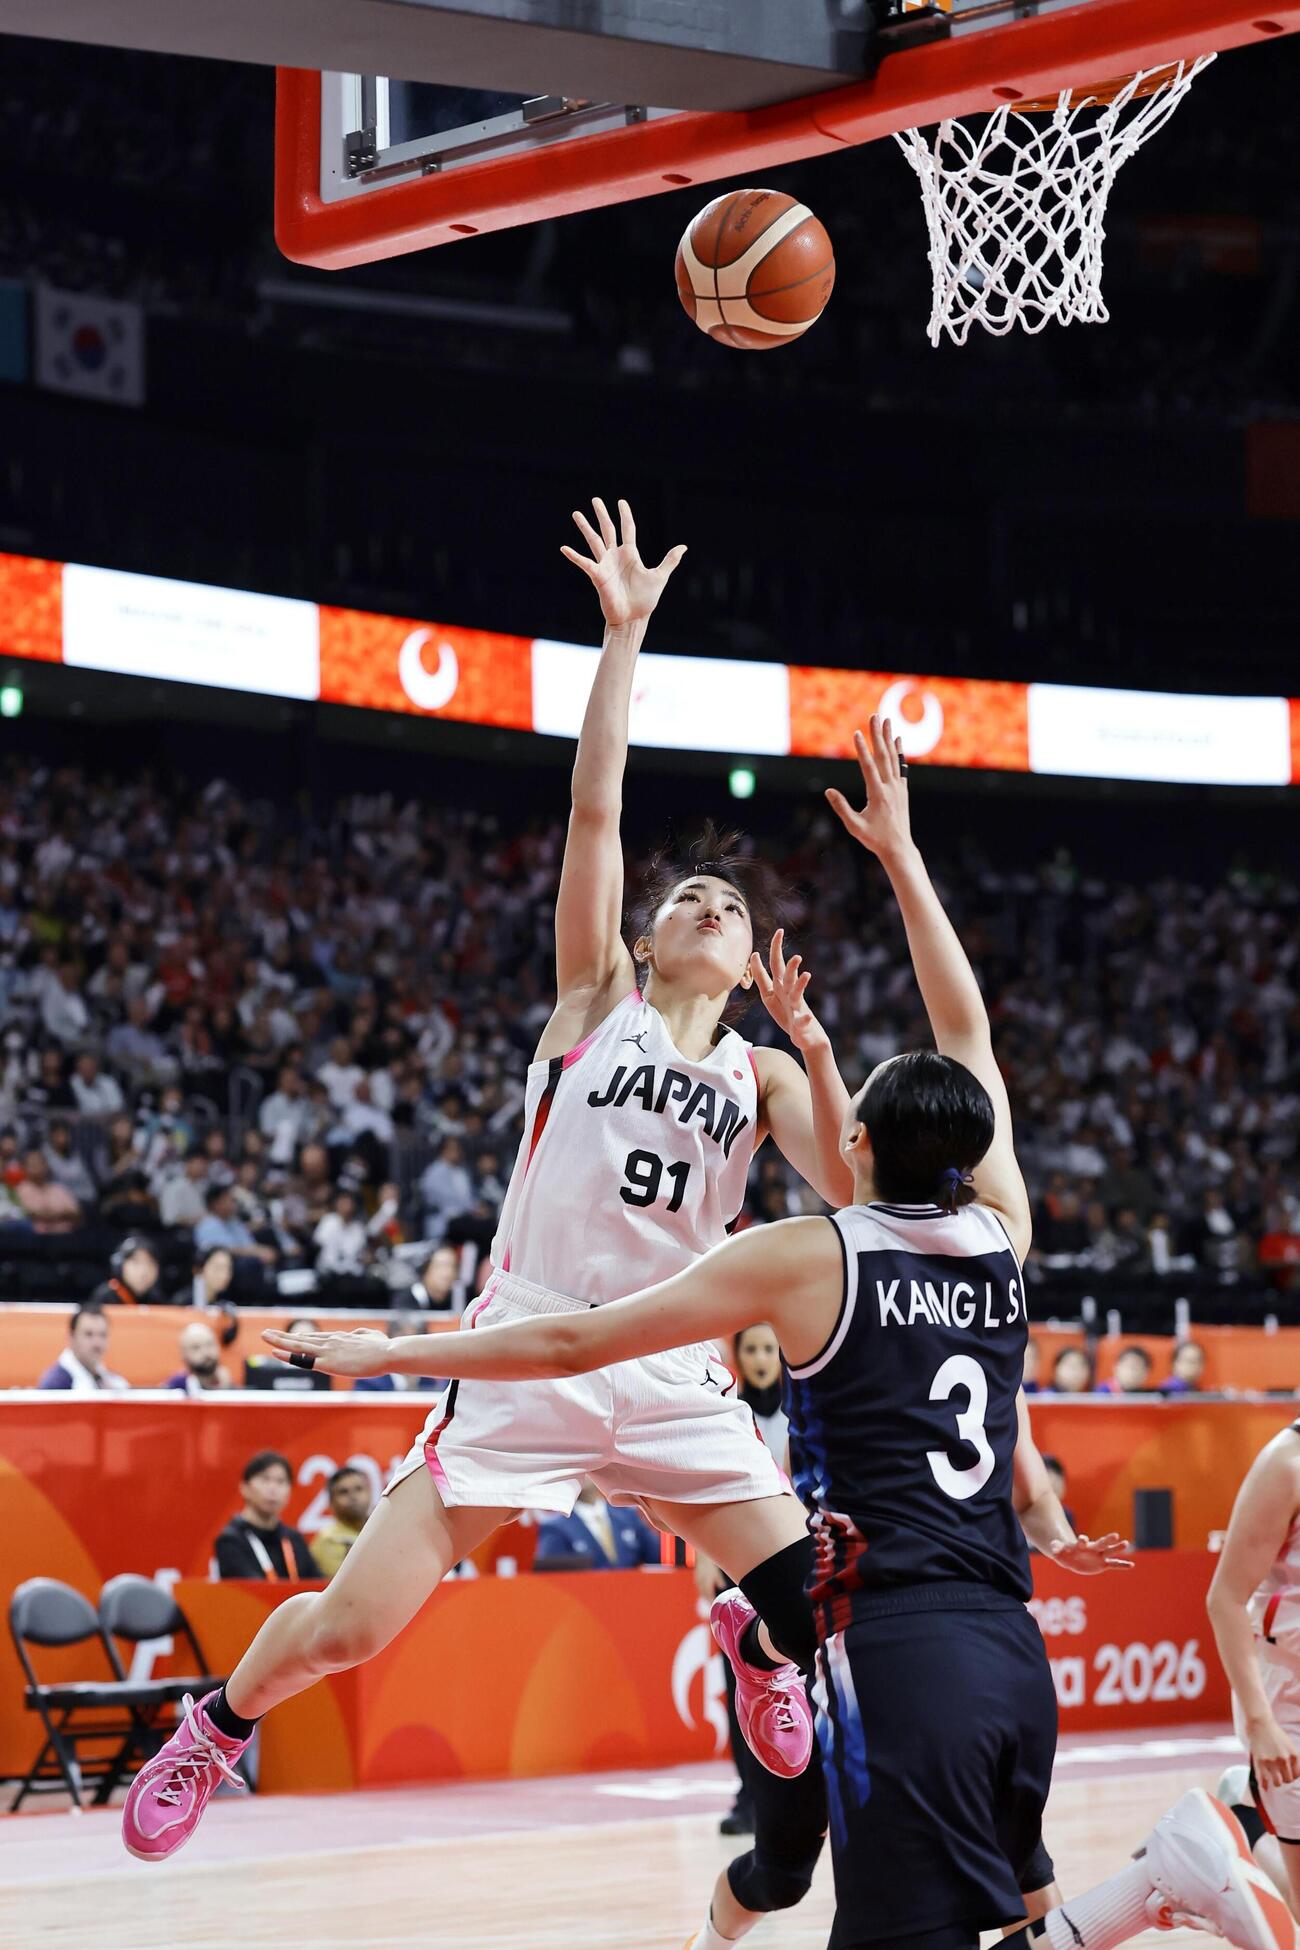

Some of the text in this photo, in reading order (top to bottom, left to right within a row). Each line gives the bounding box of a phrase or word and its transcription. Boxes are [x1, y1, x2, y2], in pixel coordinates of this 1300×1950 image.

[587, 1065, 749, 1160] JAPAN
[619, 1149, 691, 1213] 91
[876, 1279, 977, 1329] KANG
[984, 1282, 1000, 1328] L
[926, 1354, 996, 1500] 3
[1093, 1639, 1206, 1705] 2026
